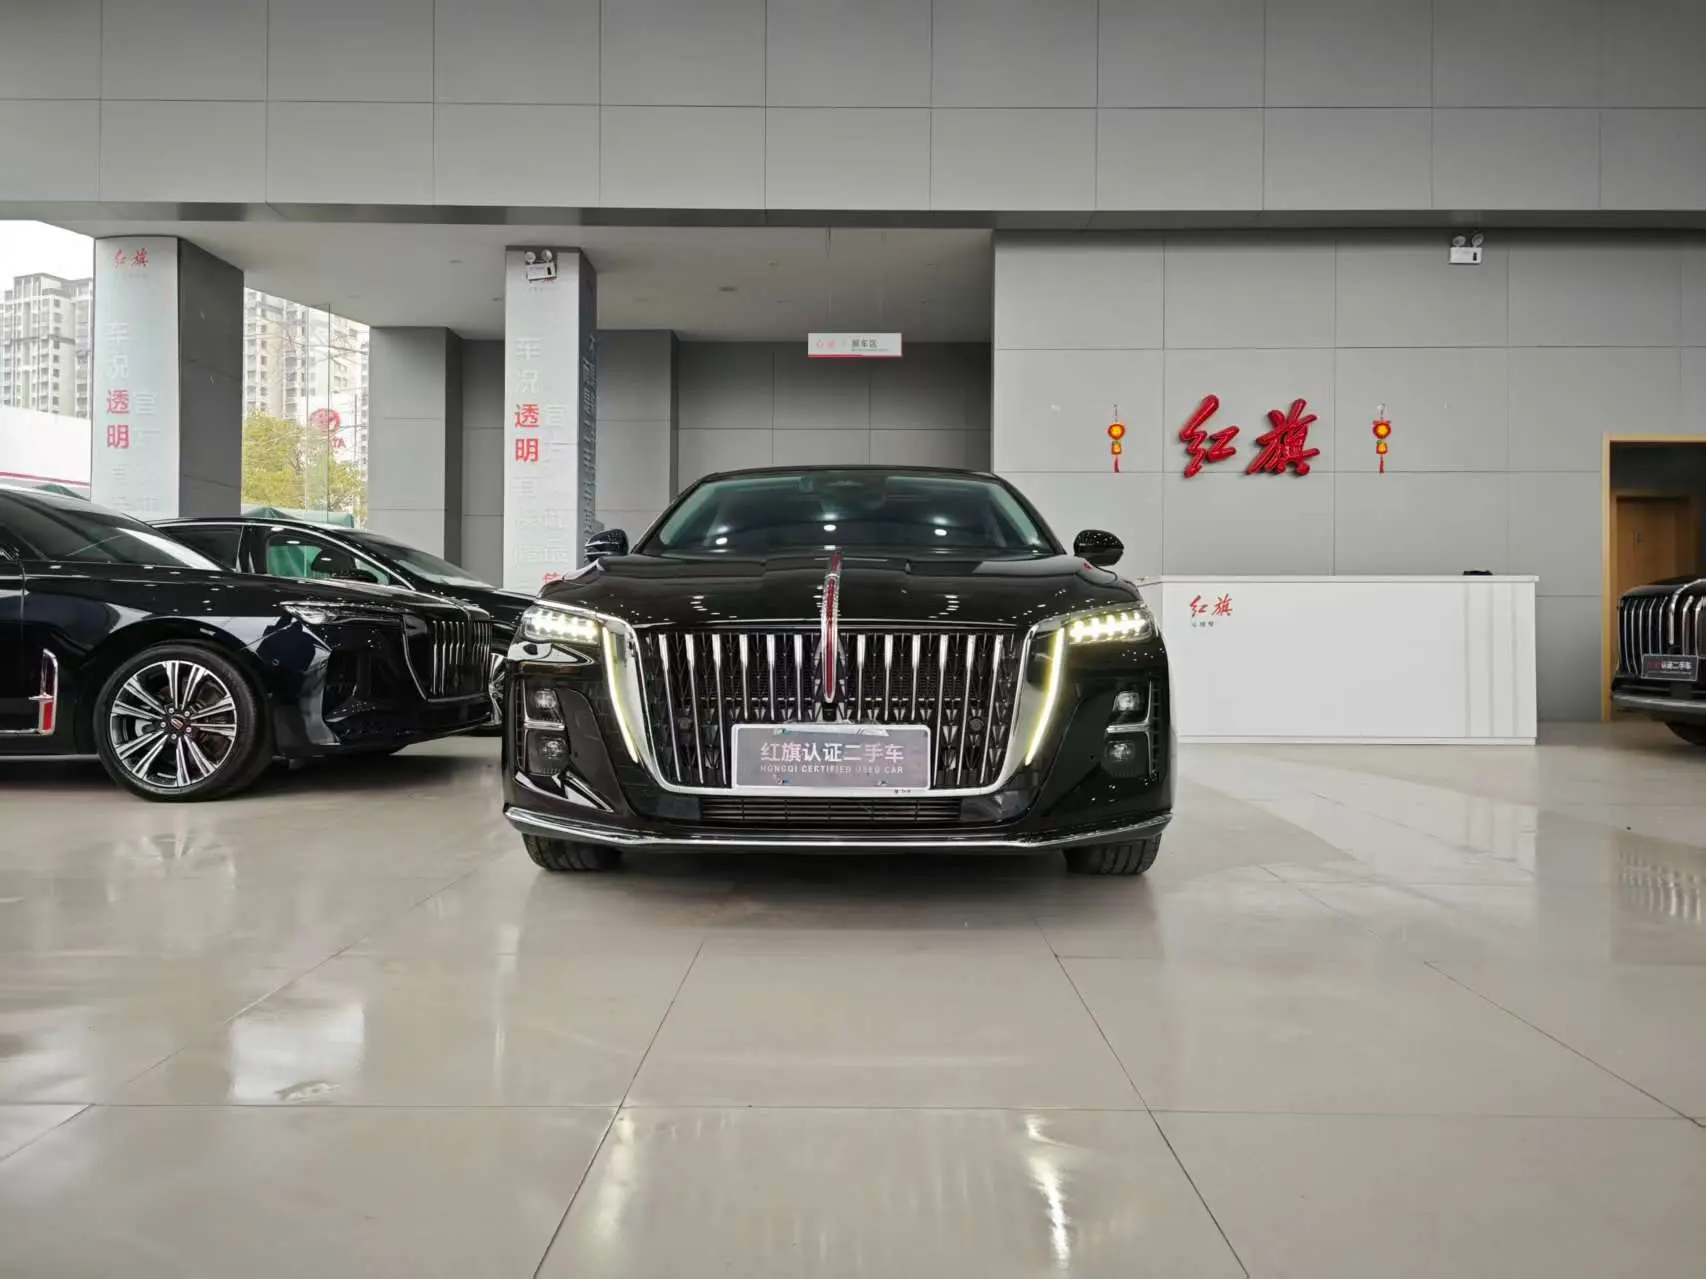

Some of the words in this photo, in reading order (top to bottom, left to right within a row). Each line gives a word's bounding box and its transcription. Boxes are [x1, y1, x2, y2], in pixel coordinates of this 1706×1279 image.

[113, 247, 149, 268] 红旗
[1179, 395, 1320, 478] 红旗
[1189, 593, 1233, 618] 红旗
[760, 741, 904, 763] 红旗认证二手车
[760, 764, 798, 773] HONGQI
[801, 764, 851, 774] CERTIFIED
[855, 764, 880, 774] USED
[884, 764, 903, 774] CAR
